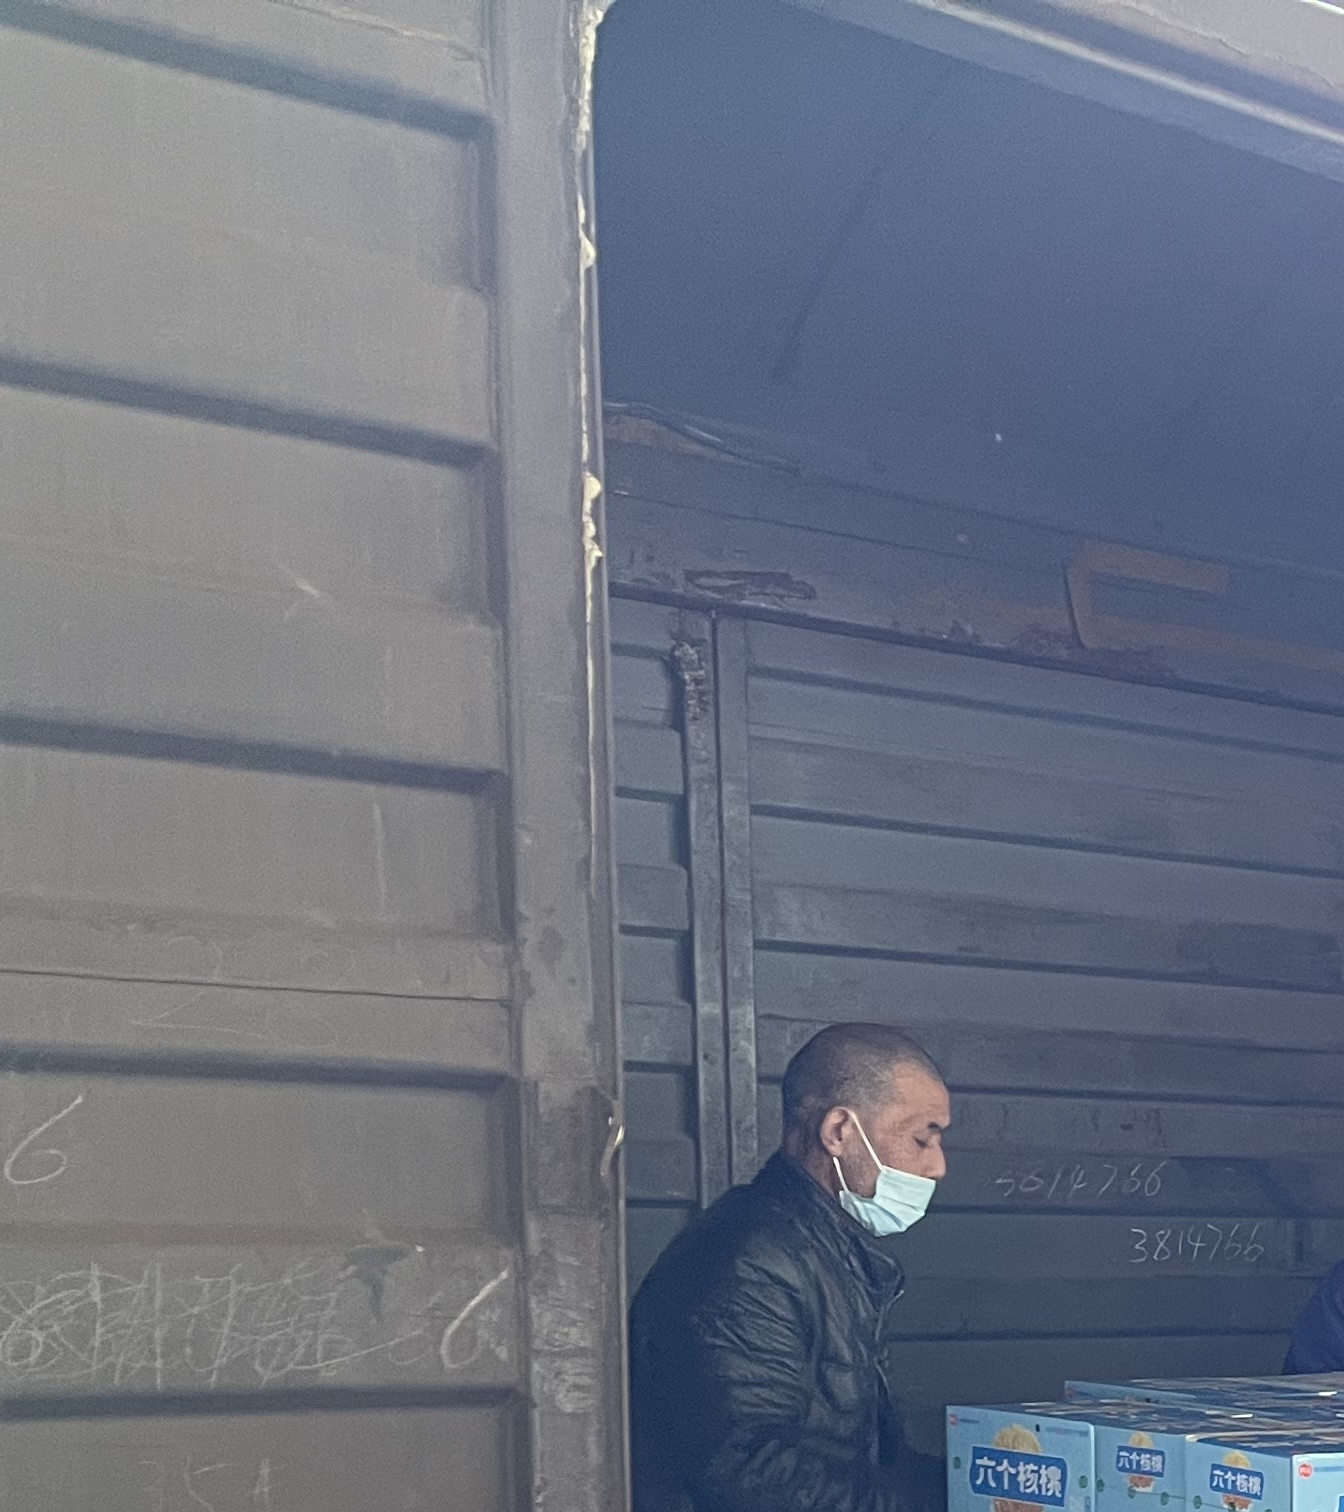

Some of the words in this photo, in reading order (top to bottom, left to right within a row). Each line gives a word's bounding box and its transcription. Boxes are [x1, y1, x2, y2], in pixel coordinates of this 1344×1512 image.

[1128, 1220, 1265, 1263] 3814766
[975, 1456, 1062, 1498] 六个核桃
[1118, 1452, 1163, 1473] 六个核桃
[1211, 1469, 1262, 1496] 六个核桃
